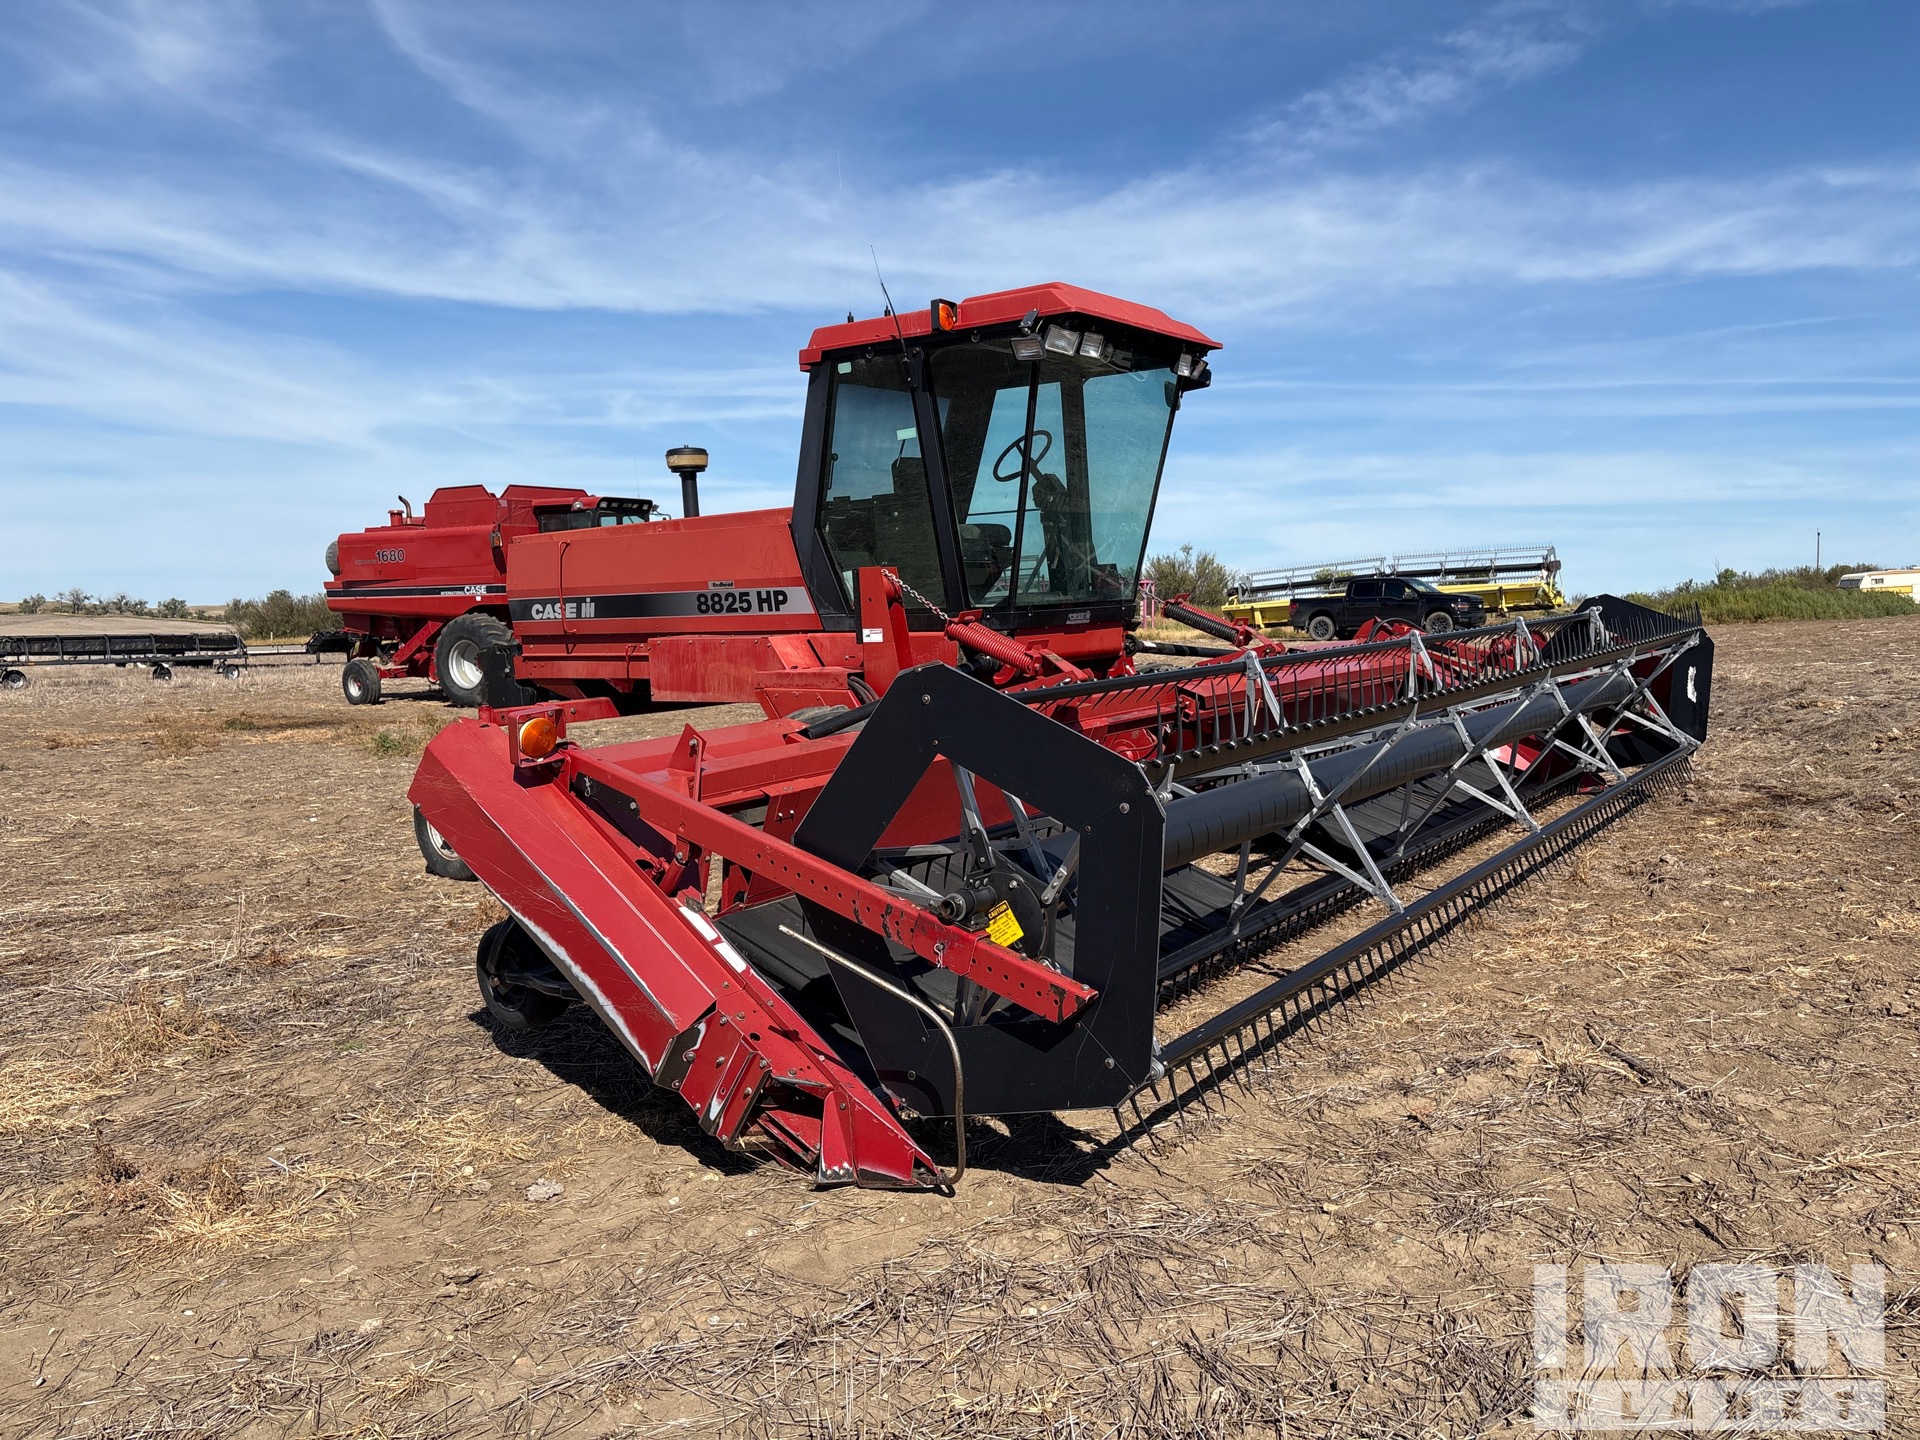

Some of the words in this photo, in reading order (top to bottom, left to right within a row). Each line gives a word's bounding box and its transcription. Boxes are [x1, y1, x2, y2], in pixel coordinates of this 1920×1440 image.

[375, 548, 405, 563] 1680
[464, 585, 487, 595] CASE
[696, 592, 752, 614] 8825
[756, 590, 788, 612] HP
[531, 603, 577, 620] CASE
[988, 903, 1008, 919] CAUTION
